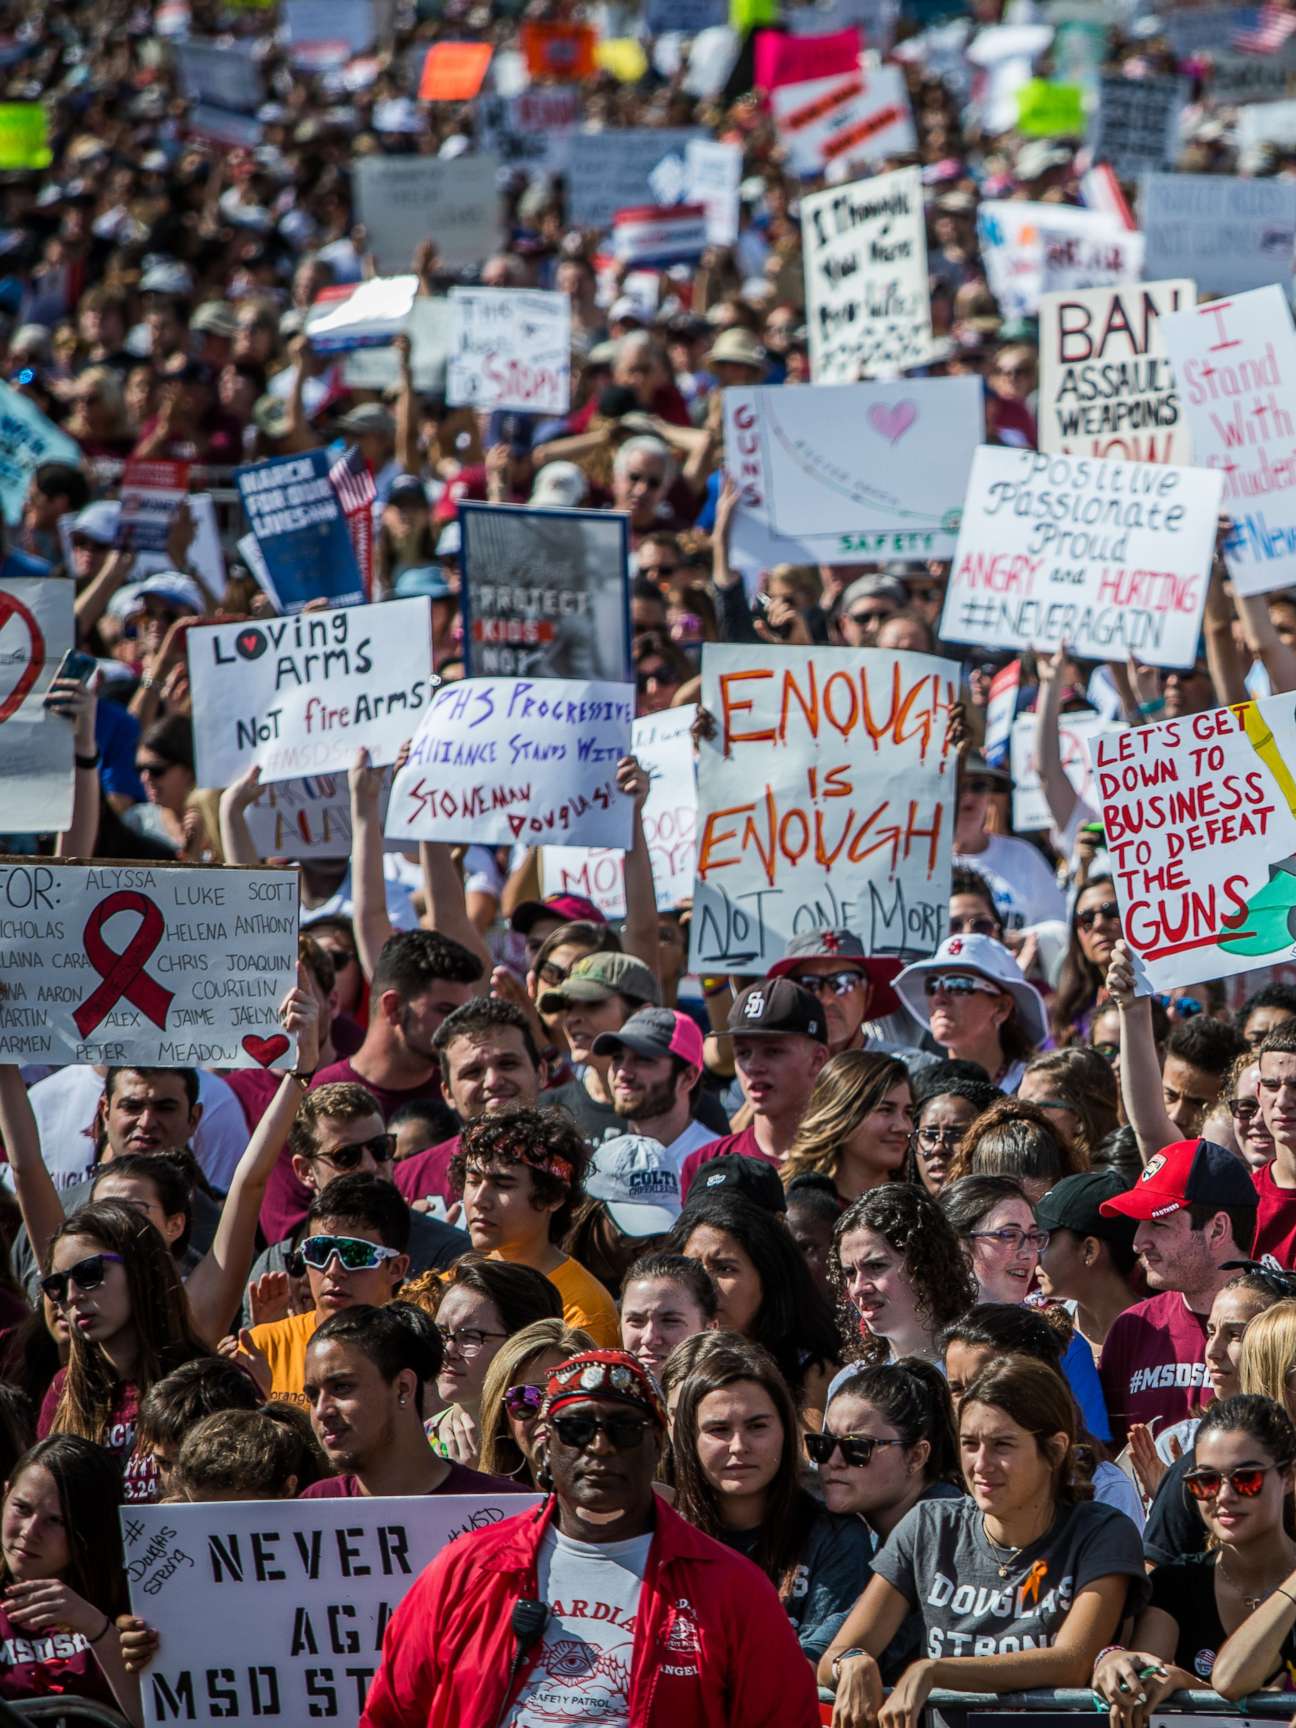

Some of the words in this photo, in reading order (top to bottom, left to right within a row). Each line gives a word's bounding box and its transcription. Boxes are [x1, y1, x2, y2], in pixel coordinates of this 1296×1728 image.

[1200, 302, 1243, 351] I
[1184, 341, 1281, 406] Stand
[1055, 394, 1180, 437] WEAPONS
[1210, 394, 1296, 449] With
[239, 457, 315, 496] MARCH
[733, 404, 764, 509] GUNS
[1020, 450, 1181, 497] Positive
[245, 489, 286, 518] FOR
[984, 481, 1187, 532] Passionate
[838, 533, 935, 553] SAFETY
[1027, 522, 1129, 563] Proud
[480, 584, 588, 616] PROTECT
[955, 552, 1044, 595] ANGRY
[1050, 568, 1086, 586] and
[1097, 566, 1200, 613] HURTING
[481, 618, 540, 643] KIDS
[961, 597, 1168, 649] #NEVERAGAIN
[426, 686, 496, 729] PHS
[720, 661, 957, 762] ENOUGH
[1097, 722, 1181, 768] LET'S
[1193, 704, 1250, 740] GET
[808, 763, 853, 800] IS
[1100, 757, 1178, 800] DOWN
[1190, 745, 1224, 777] TO
[1104, 772, 1265, 842] BUSINESS
[698, 784, 944, 888] ENOUGH
[1110, 840, 1151, 869] TO
[1167, 806, 1275, 858] DEFEAT
[86, 869, 156, 889] ALYSSA
[174, 887, 225, 906] LUKE
[249, 882, 296, 902] SCOTT
[1118, 859, 1190, 900] THE
[0, 921, 64, 941] ICHOLAS
[166, 922, 227, 942] HELENA
[235, 915, 294, 937] ANTHONY
[698, 887, 783, 957] NOT
[793, 882, 858, 936] ONE
[868, 878, 947, 952] MORE
[1124, 875, 1249, 951] GUNS
[0, 952, 44, 969] LAINA
[157, 953, 208, 973] CHRIS
[226, 953, 291, 972] JOAQUIN
[37, 985, 83, 1002] AARON
[192, 978, 277, 998] COURTLIN
[104, 1010, 141, 1028] ALEX
[171, 1008, 215, 1028] JAIME
[0, 1034, 51, 1053] ARMEN
[75, 1043, 127, 1060] PETER
[158, 1041, 237, 1062] MEADOW
[208, 1525, 413, 1584] NEVER
[927, 1571, 1074, 1620] DOUGLAS
[927, 1626, 1050, 1660] STRON
[152, 1665, 281, 1721] MSD
[530, 1691, 570, 1704] SAFETY
[571, 1696, 611, 1709] PATROL
